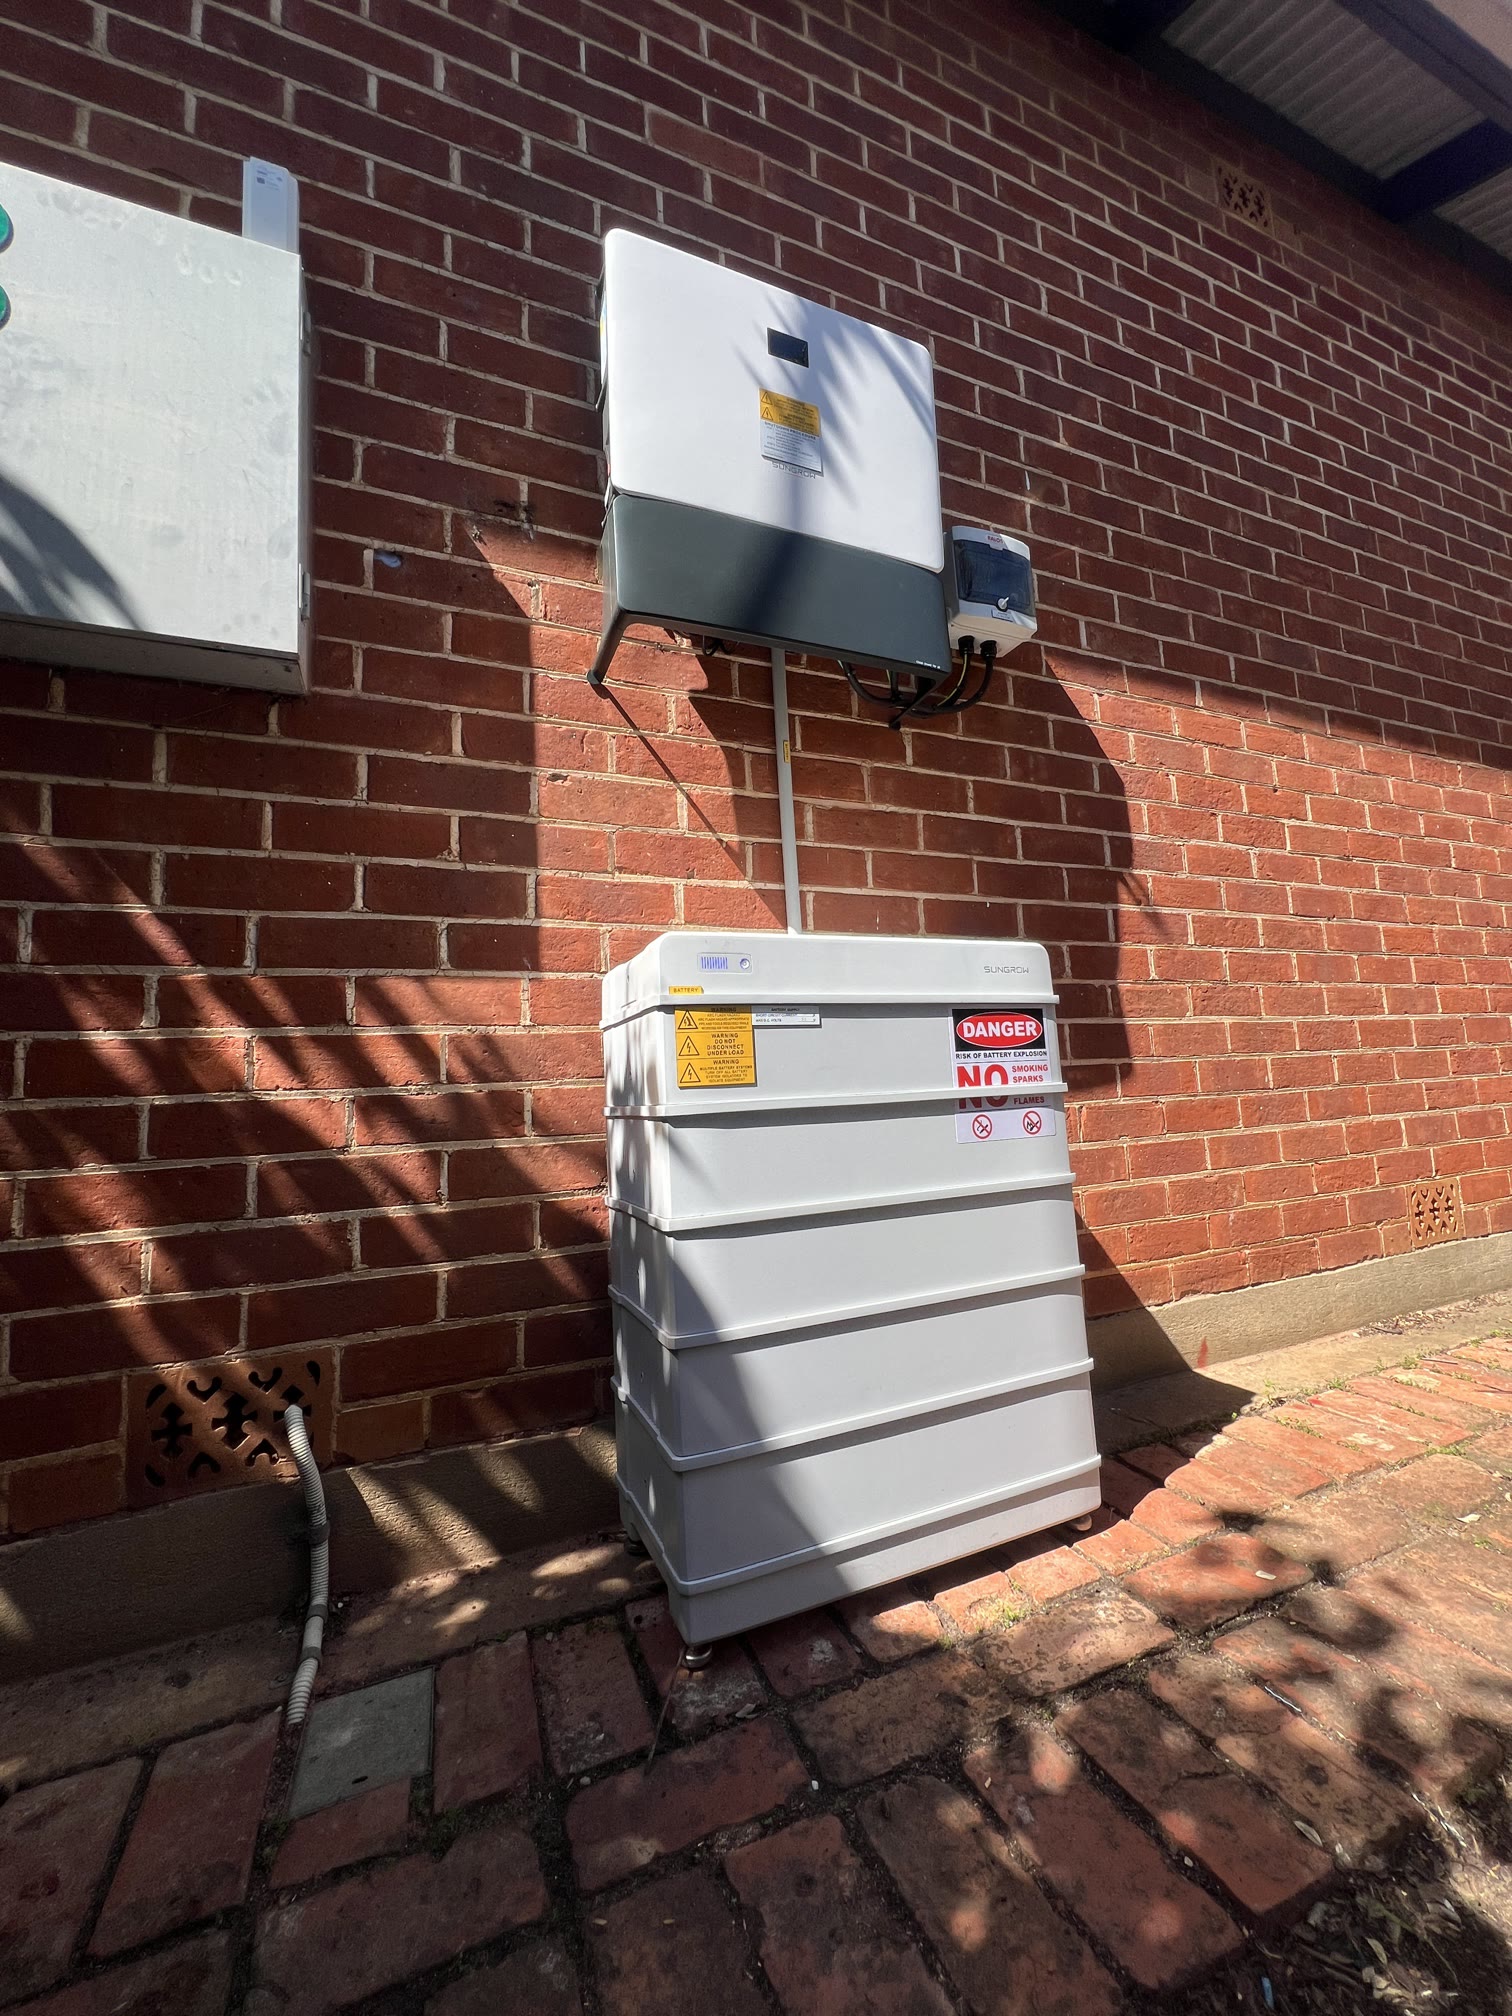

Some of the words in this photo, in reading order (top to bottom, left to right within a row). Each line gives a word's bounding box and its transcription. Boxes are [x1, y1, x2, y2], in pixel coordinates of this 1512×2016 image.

[772, 462, 816, 480] SUNGROW
[984, 966, 1029, 974] SUNGROW
[962, 1020, 1038, 1038] DANGER
[1012, 1065, 1048, 1073] SMOKING
[1013, 1075, 1044, 1083] SPARKS
[957, 1064, 1009, 1109] NO
[1013, 1096, 1045, 1104] FLAMES
